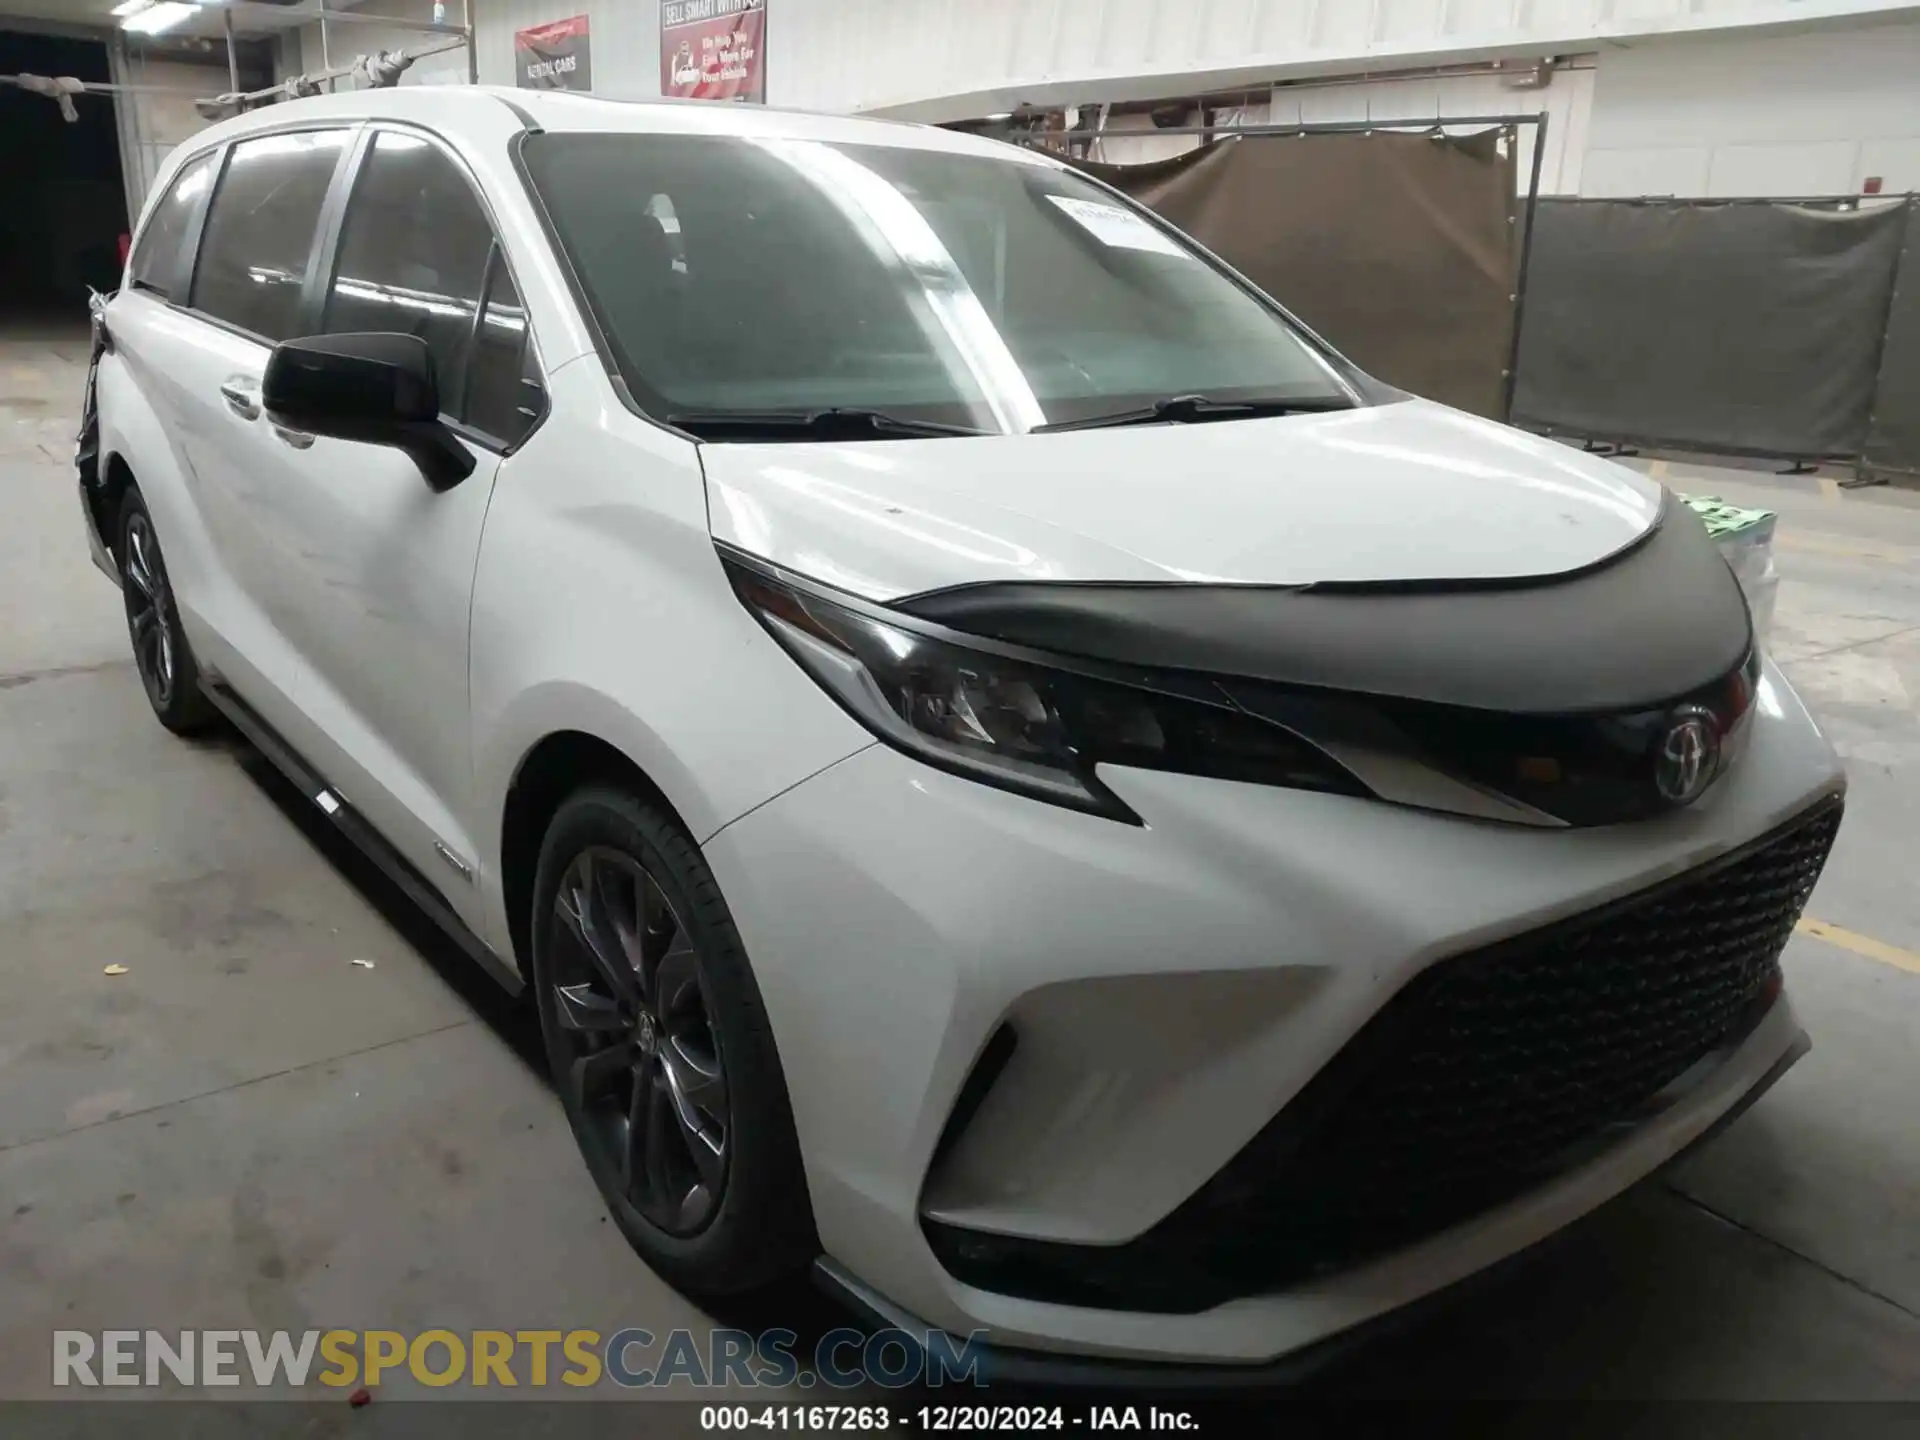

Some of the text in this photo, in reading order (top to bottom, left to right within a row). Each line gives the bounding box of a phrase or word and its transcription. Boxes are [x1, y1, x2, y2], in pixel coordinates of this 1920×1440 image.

[665, 5, 685, 24] SELL
[685, 0, 715, 21] SMART
[555, 55, 577, 75] CARS
